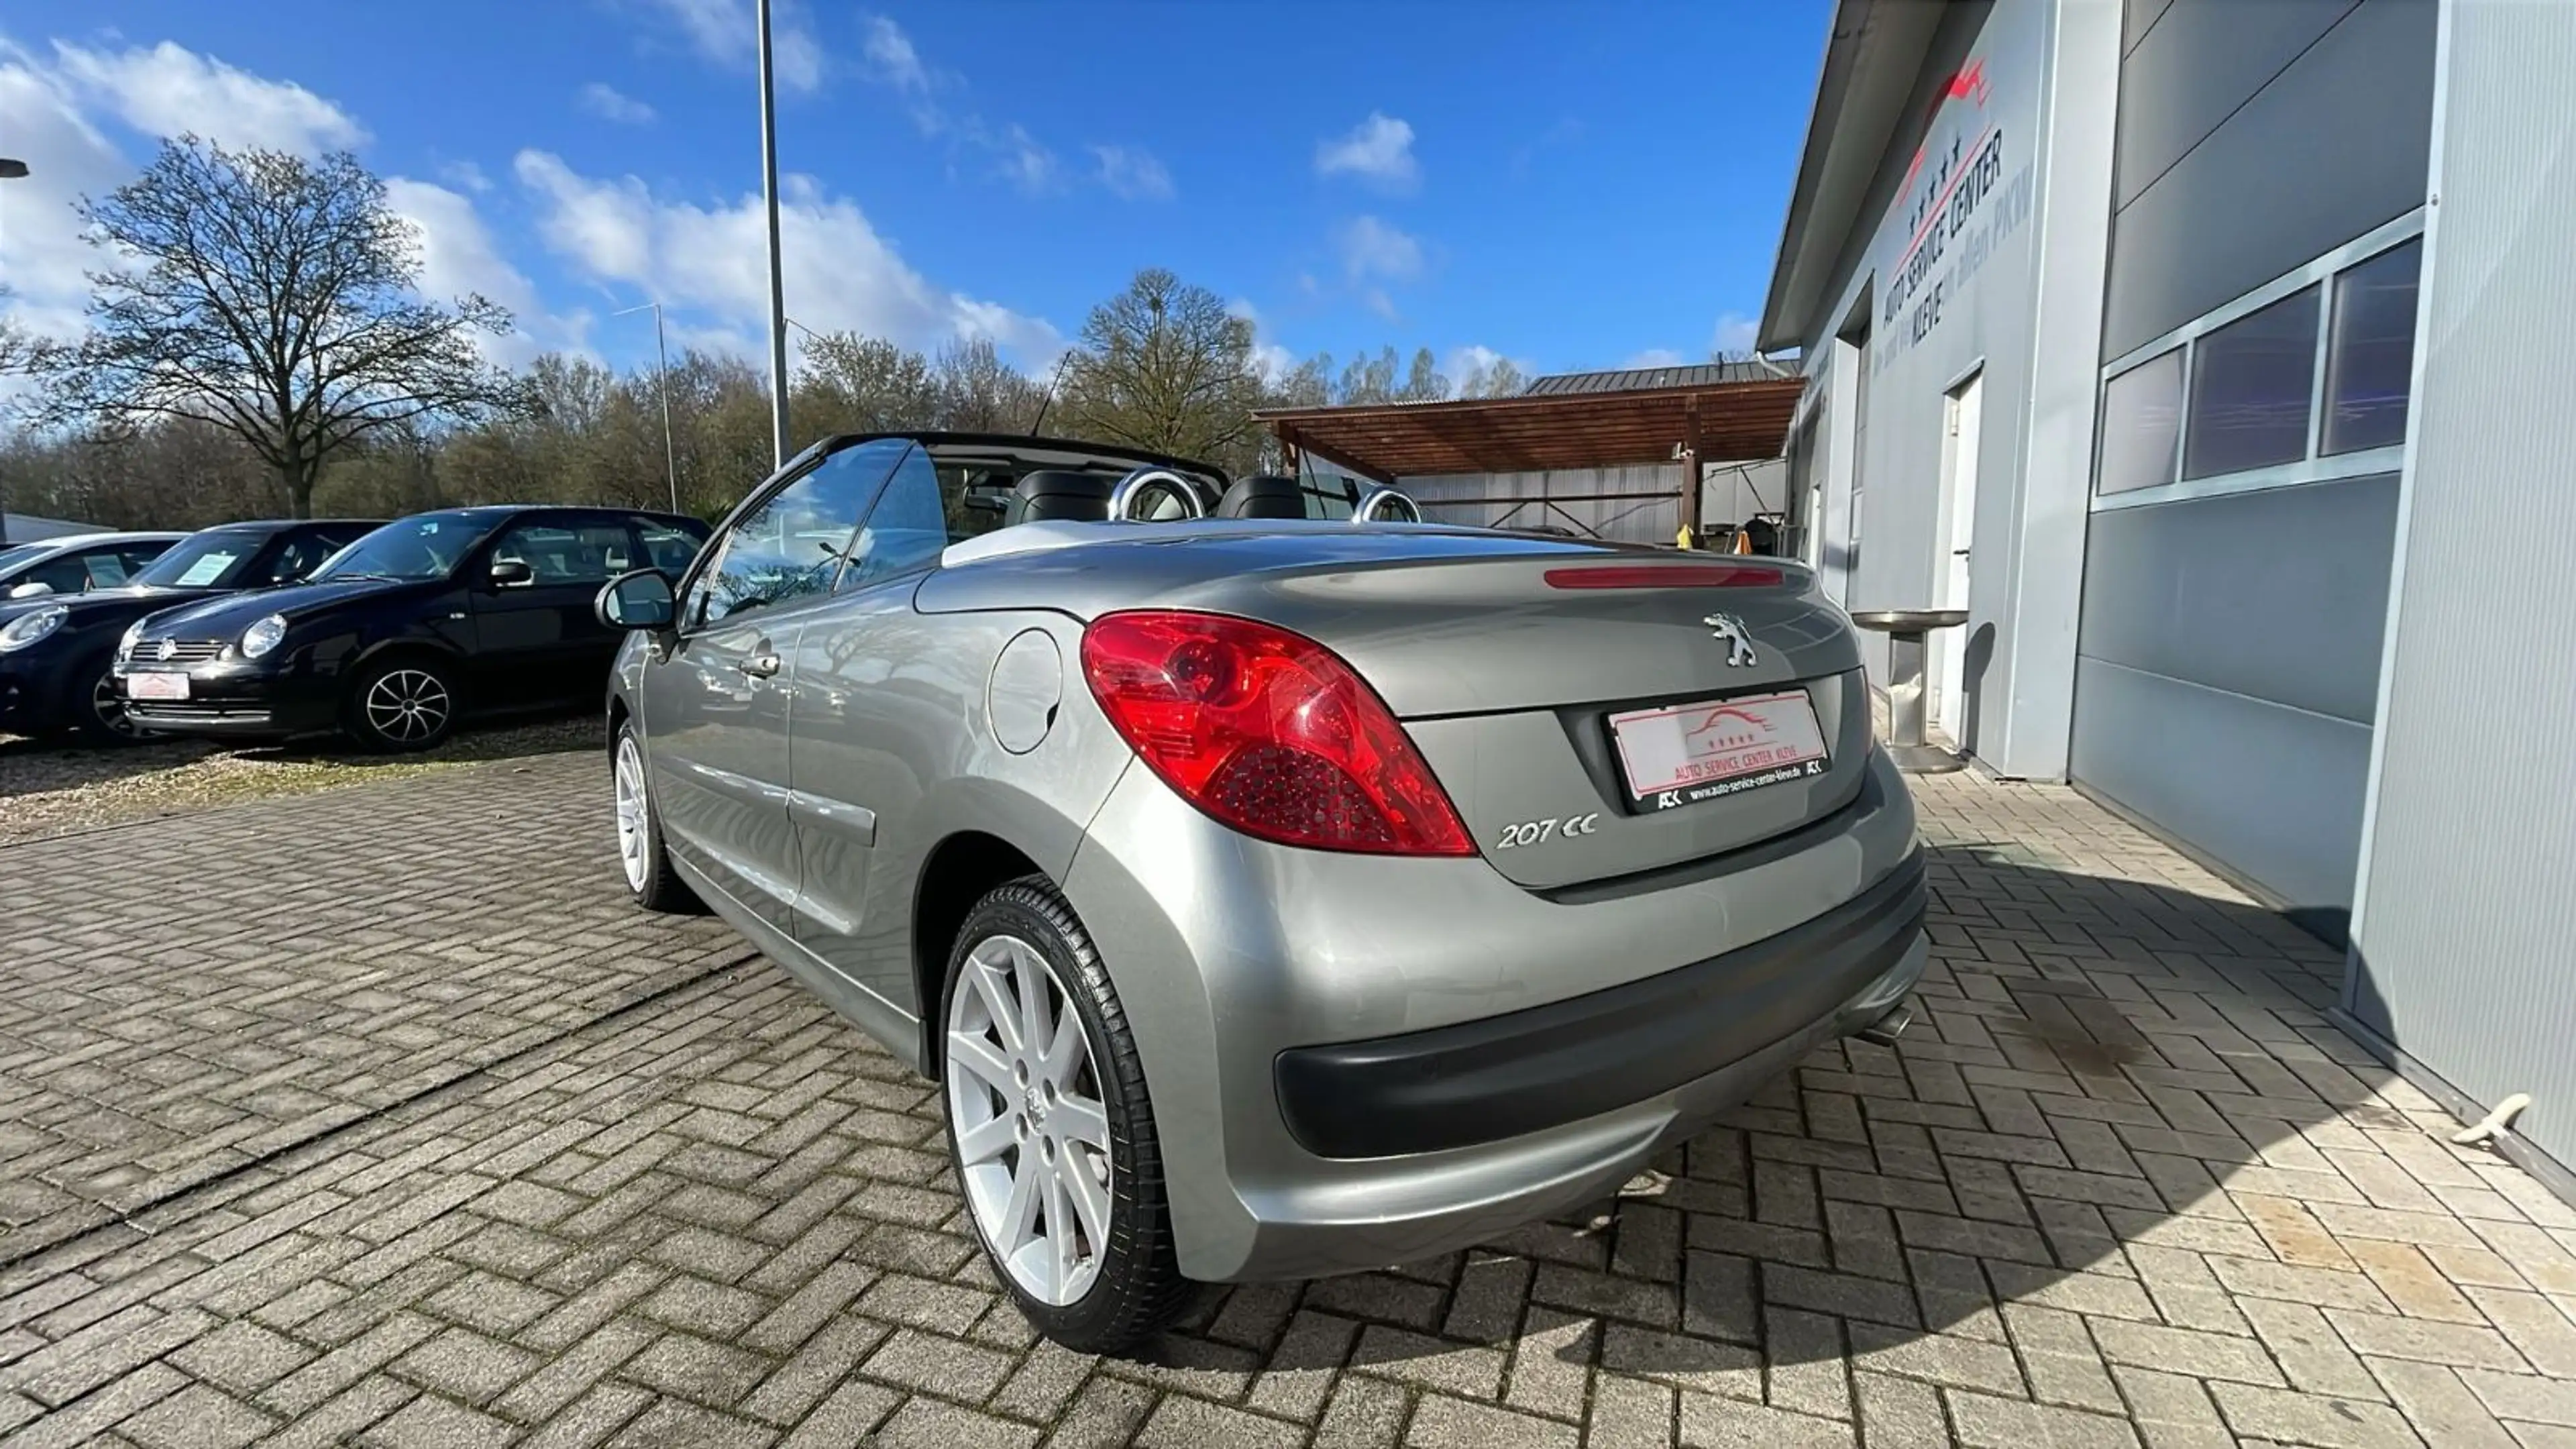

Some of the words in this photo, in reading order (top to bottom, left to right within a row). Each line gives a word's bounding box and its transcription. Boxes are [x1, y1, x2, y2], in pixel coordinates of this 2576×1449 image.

[1883, 274, 1904, 330] AUTO
[1907, 210, 1945, 299] SERVICE
[1950, 129, 2002, 239] CENTER
[1911, 280, 1943, 348] KLEVE
[1675, 761, 1701, 780] AUTO
[1705, 756, 1739, 774] SERVICE
[1743, 749, 1774, 767] CENTER
[1496, 818, 1557, 849] 207
[1561, 813, 1598, 838] CC
